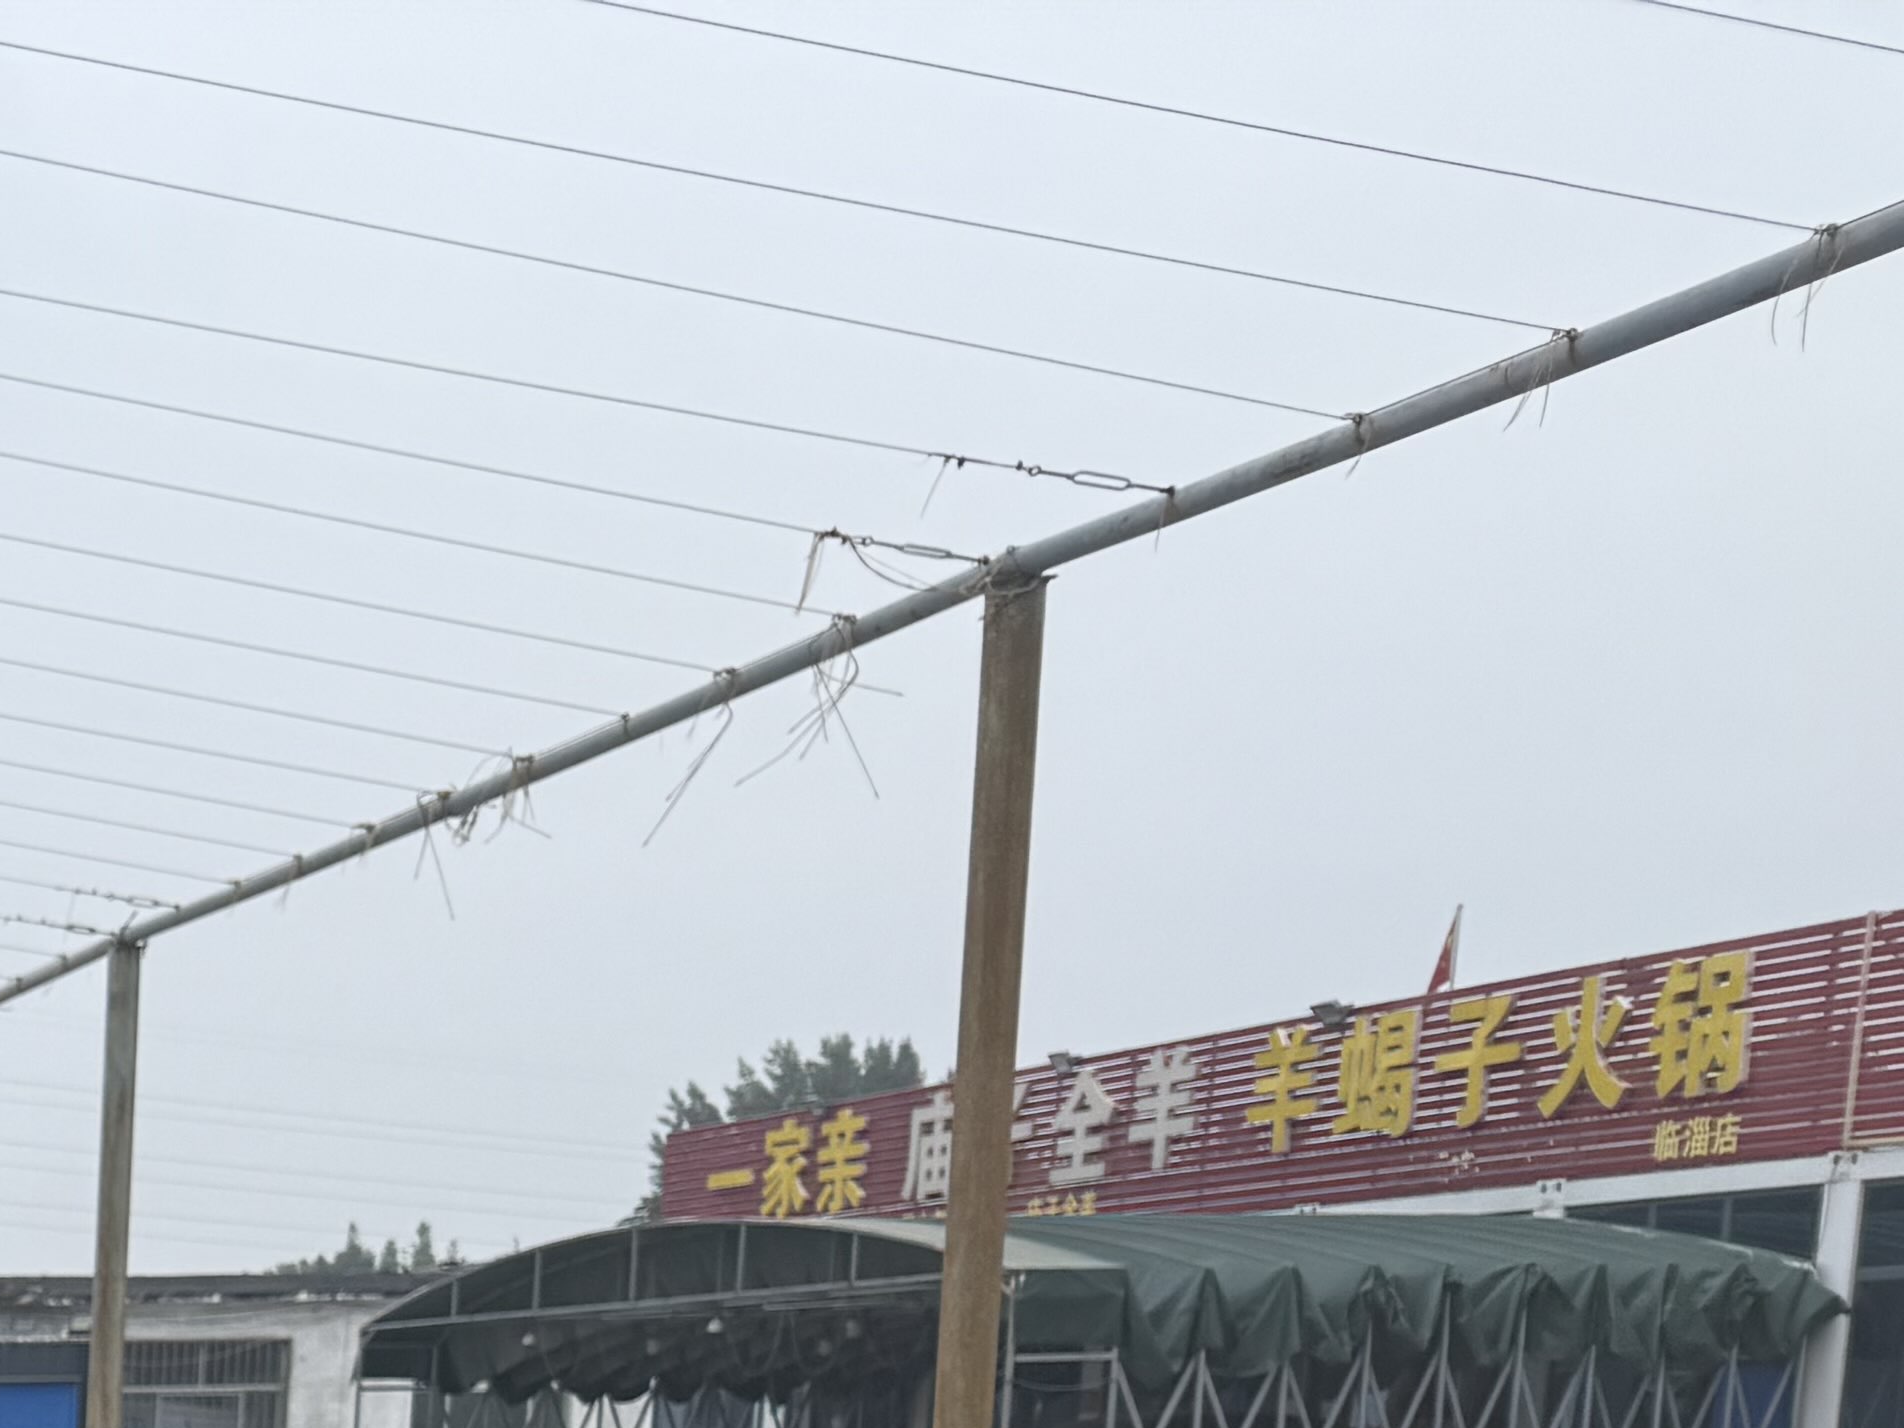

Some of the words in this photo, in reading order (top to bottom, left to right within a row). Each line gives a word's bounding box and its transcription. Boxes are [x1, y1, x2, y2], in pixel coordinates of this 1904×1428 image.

[706, 1108, 870, 1218] 一家亲
[902, 1050, 1200, 1201] 庙全羊
[1246, 949, 1755, 1154] 羊蝎子火锅
[1653, 1113, 1741, 1161] 临淄店
